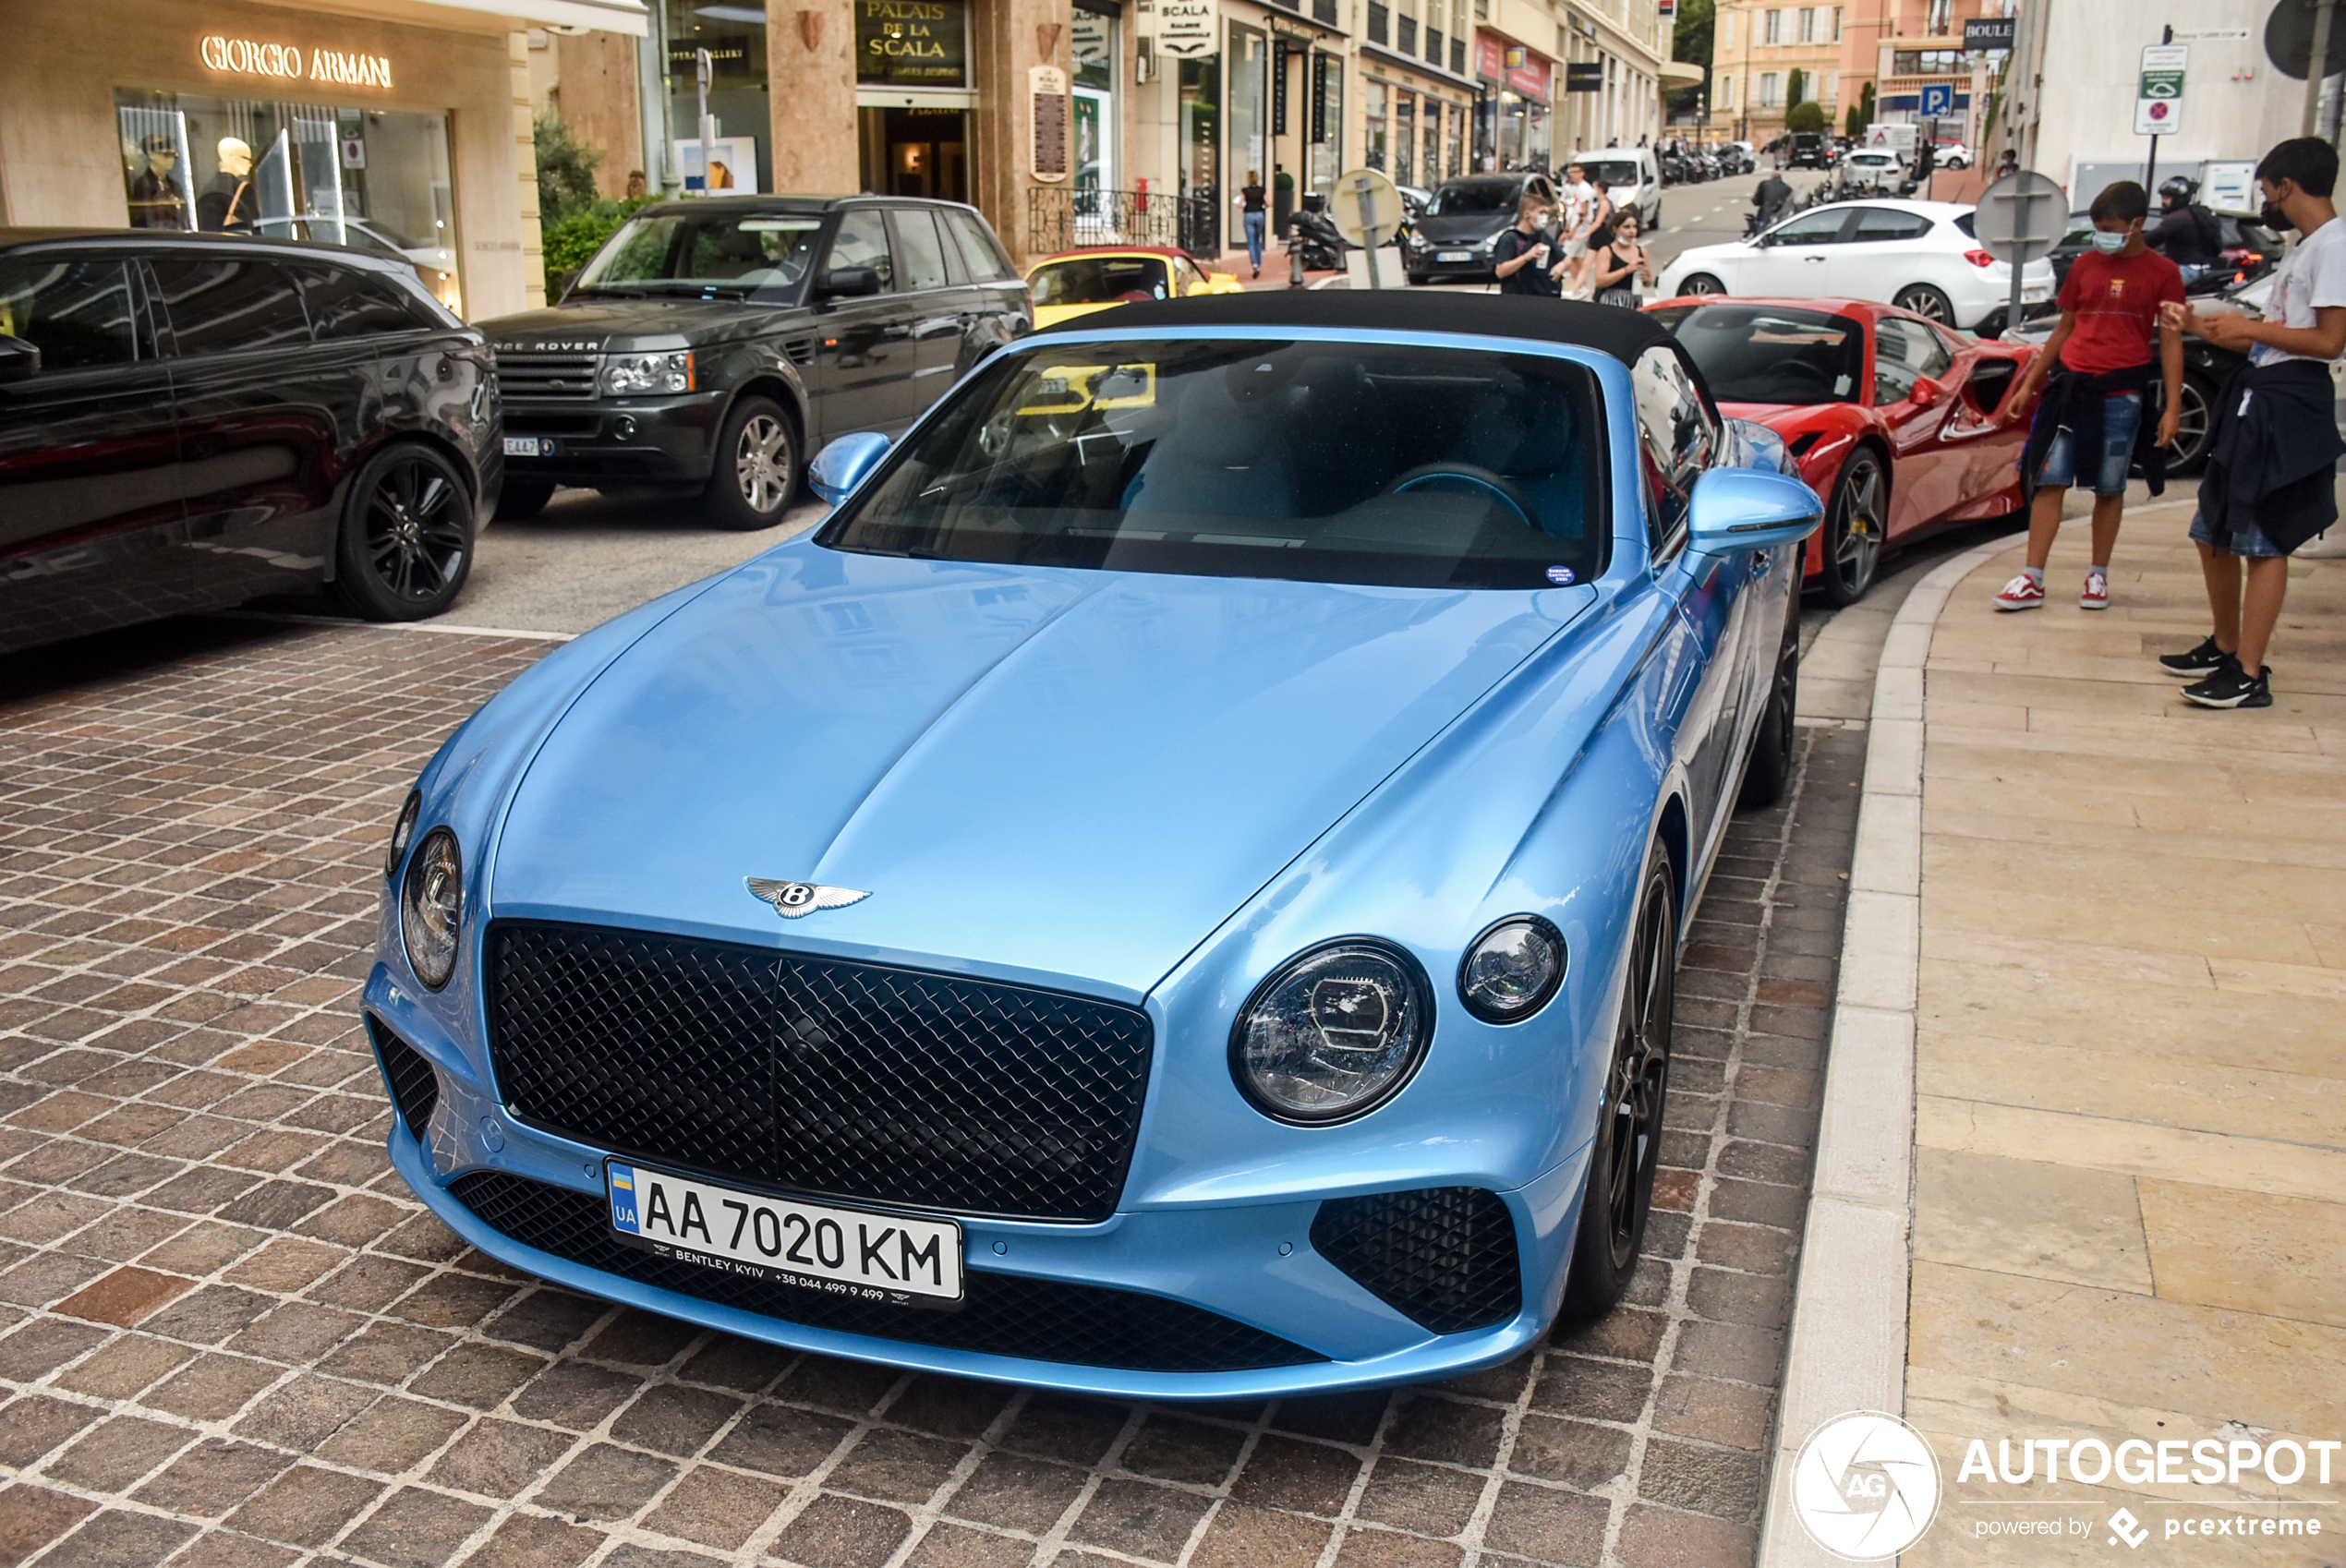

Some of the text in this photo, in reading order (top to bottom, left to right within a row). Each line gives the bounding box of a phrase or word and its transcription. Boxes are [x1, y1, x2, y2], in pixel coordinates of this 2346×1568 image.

[867, 2, 945, 19] PALAIS
[1162, 6, 1210, 17] SCALA
[883, 22, 931, 36] DE LA
[1965, 25, 2013, 37] BOULE
[869, 39, 945, 57] SCALA
[201, 35, 393, 89] GIORGIO ARMANI
[1928, 90, 1943, 112] P
[492, 342, 599, 351] NGE ROVER
[615, 1206, 636, 1224] UA
[647, 1182, 942, 1286] AA 7020 KM
[675, 1249, 884, 1301] BENTLEY KYIV +38 044 499 9 499
